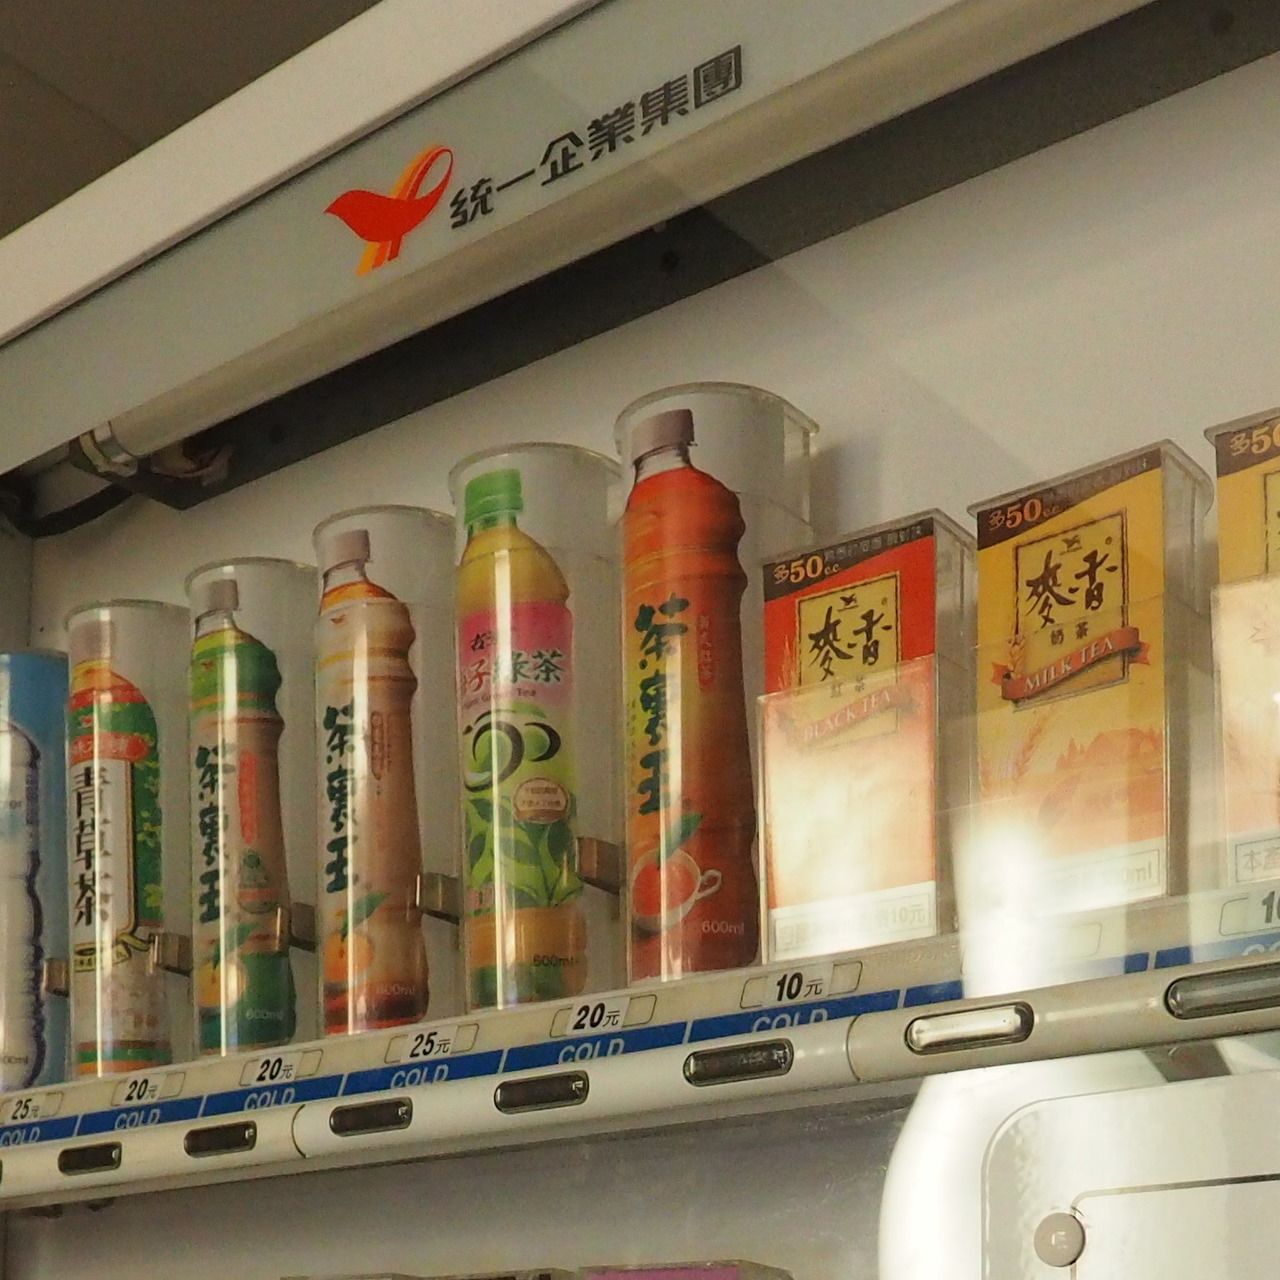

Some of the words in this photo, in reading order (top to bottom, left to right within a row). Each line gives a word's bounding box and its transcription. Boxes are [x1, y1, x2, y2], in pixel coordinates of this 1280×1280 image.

[449, 44, 742, 229] 統一企業集團
[1026, 548, 1119, 630] 麥香
[809, 604, 893, 682] 麥香
[1050, 620, 1090, 648] 奶茶
[1023, 654, 1073, 692] MILK
[1077, 637, 1115, 665] TEA
[776, 971, 824, 999] 10元
[573, 1003, 619, 1030] 20元
[751, 1008, 829, 1031] COLD
[410, 1033, 450, 1057] 25元
[559, 1038, 624, 1065] COLD
[256, 1060, 294, 1081] 20元
[390, 1063, 450, 1090] COLD
[125, 1079, 158, 1101] 20元
[242, 1087, 294, 1111] COLD
[11, 1098, 40, 1120] 25元
[115, 1109, 159, 1129] COLD
[0, 1126, 40, 1146] COLD
